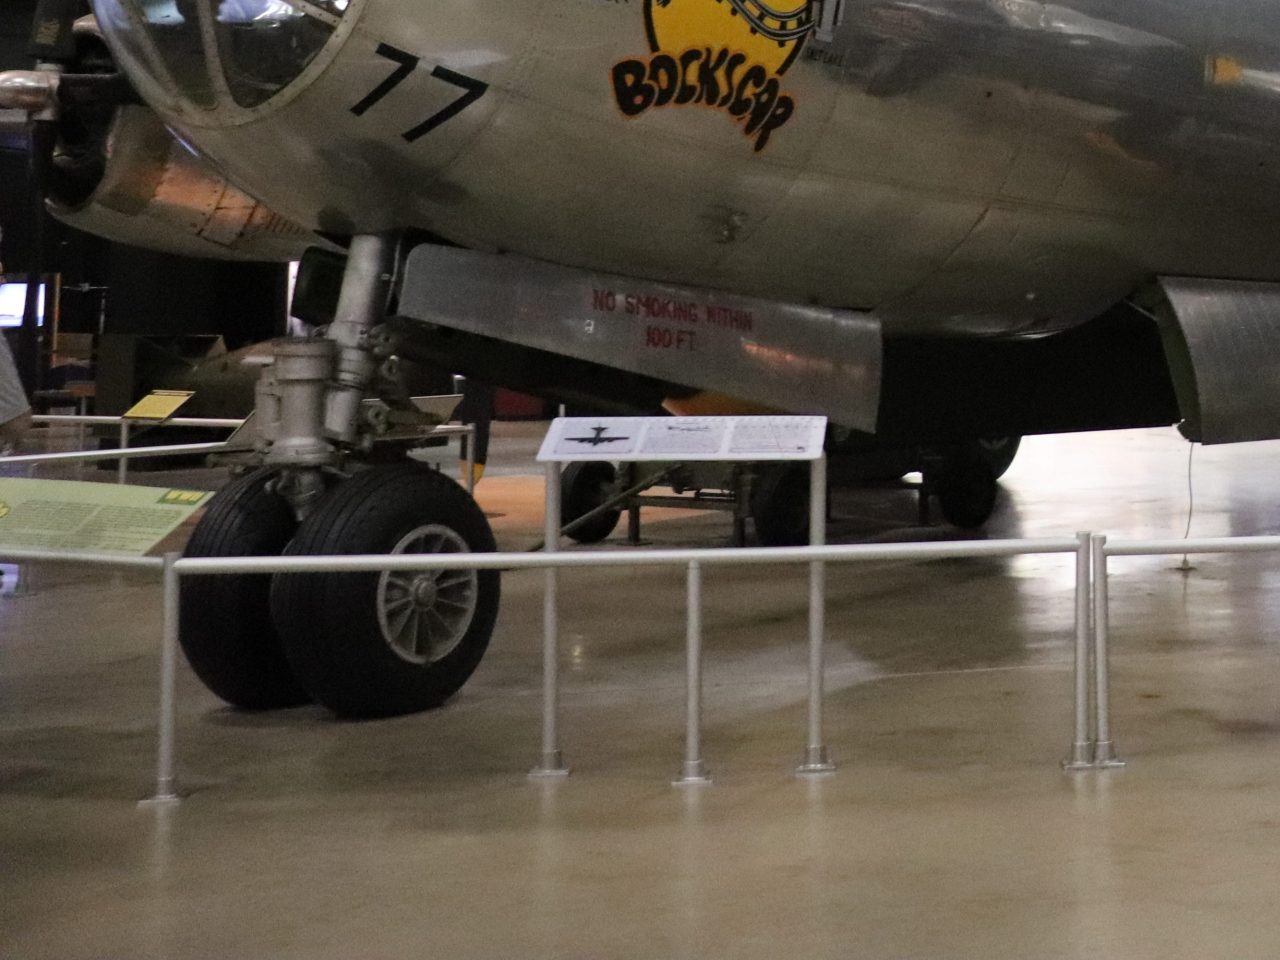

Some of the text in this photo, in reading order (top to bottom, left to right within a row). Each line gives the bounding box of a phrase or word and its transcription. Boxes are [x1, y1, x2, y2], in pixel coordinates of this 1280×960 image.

[350, 42, 489, 142] 77
[611, 46, 796, 153] BOCKSCAR
[592, 289, 753, 332] NO SMOKING WITHIN
[646, 325, 696, 352] 100 FT
